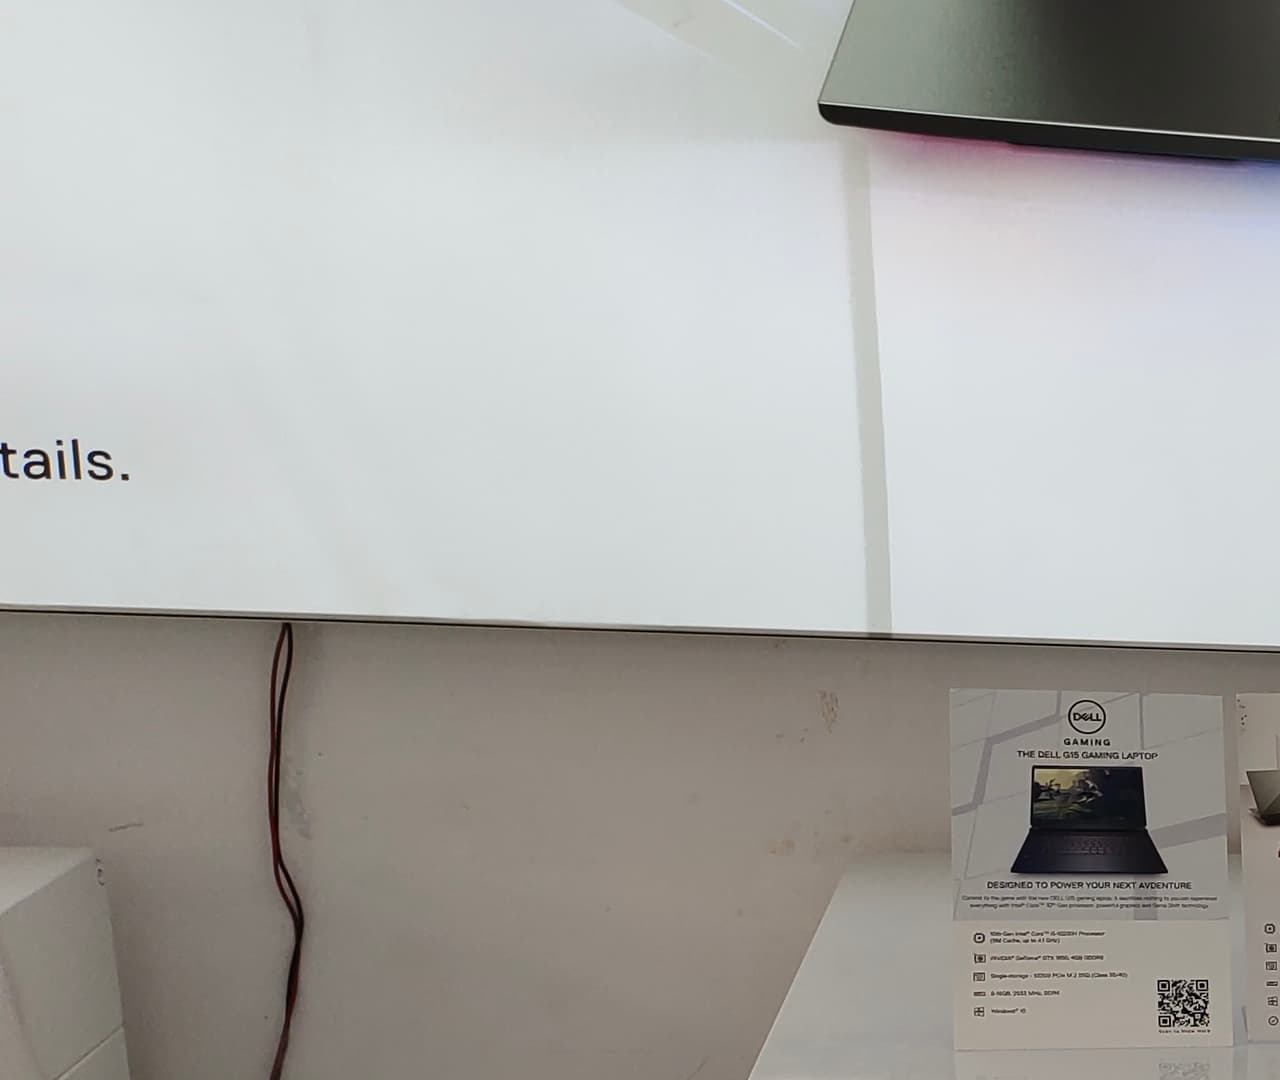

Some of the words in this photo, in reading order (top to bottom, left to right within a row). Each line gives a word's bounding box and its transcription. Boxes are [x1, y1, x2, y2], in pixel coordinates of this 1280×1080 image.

[0, 438, 130, 481] tails.
[1072, 712, 1102, 722] DELL
[1063, 738, 1111, 746] GAMING
[1017, 750, 1036, 758] THE
[1037, 751, 1061, 759] DELL
[1063, 751, 1079, 759] G15
[1081, 752, 1119, 760] GAMING
[1121, 752, 1158, 760] LAPTOP
[987, 881, 1033, 889] DESIGNED
[1035, 881, 1048, 889] TO
[1050, 881, 1084, 889] POWER
[1085, 881, 1111, 889] YOUR
